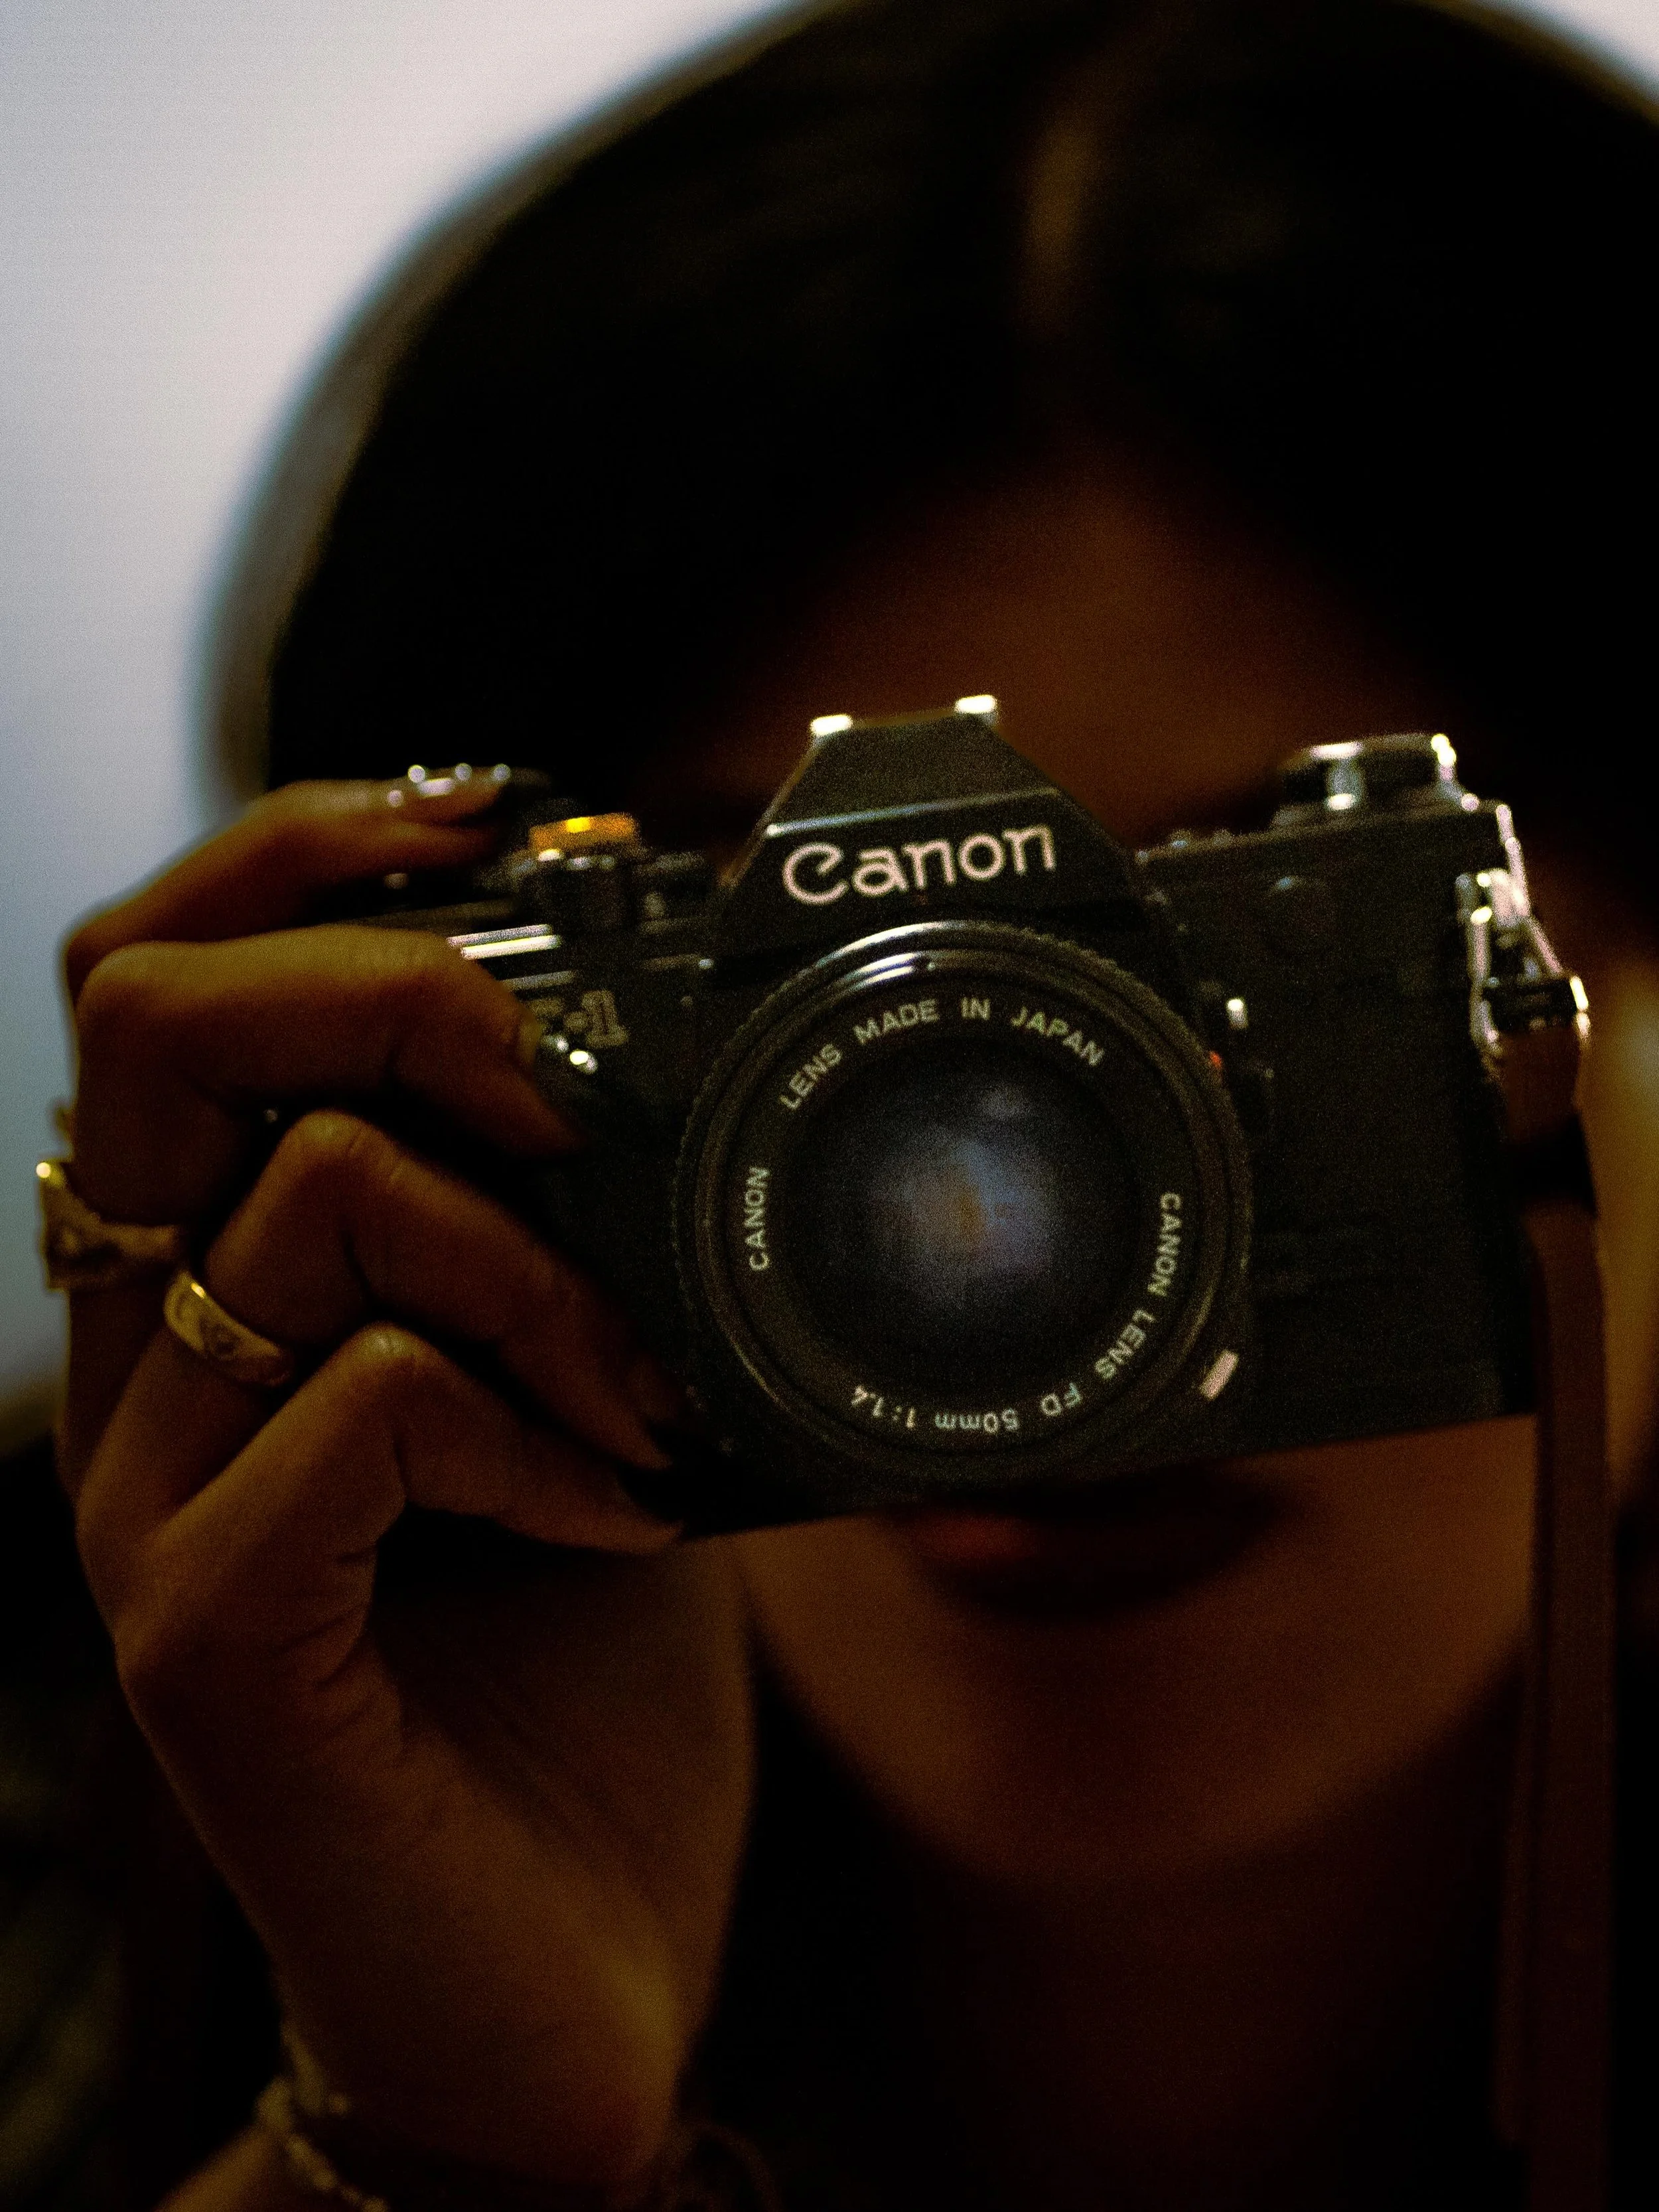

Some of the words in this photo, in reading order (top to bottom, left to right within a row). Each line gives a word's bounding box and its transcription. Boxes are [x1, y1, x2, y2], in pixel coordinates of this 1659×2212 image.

[781, 822, 1058, 906] Canon
[778, 1042, 844, 1112] LENS
[853, 998, 941, 1045] MADE
[960, 996, 991, 1021] IN
[1010, 1005, 1106, 1067] JAPAN
[743, 1165, 771, 1272] CANON
[1146, 1192, 1182, 1297] CANON
[1094, 1307, 1157, 1380] LENS
[933, 1406, 1021, 1435] 50mm
[1039, 1381, 1084, 1418] FD
